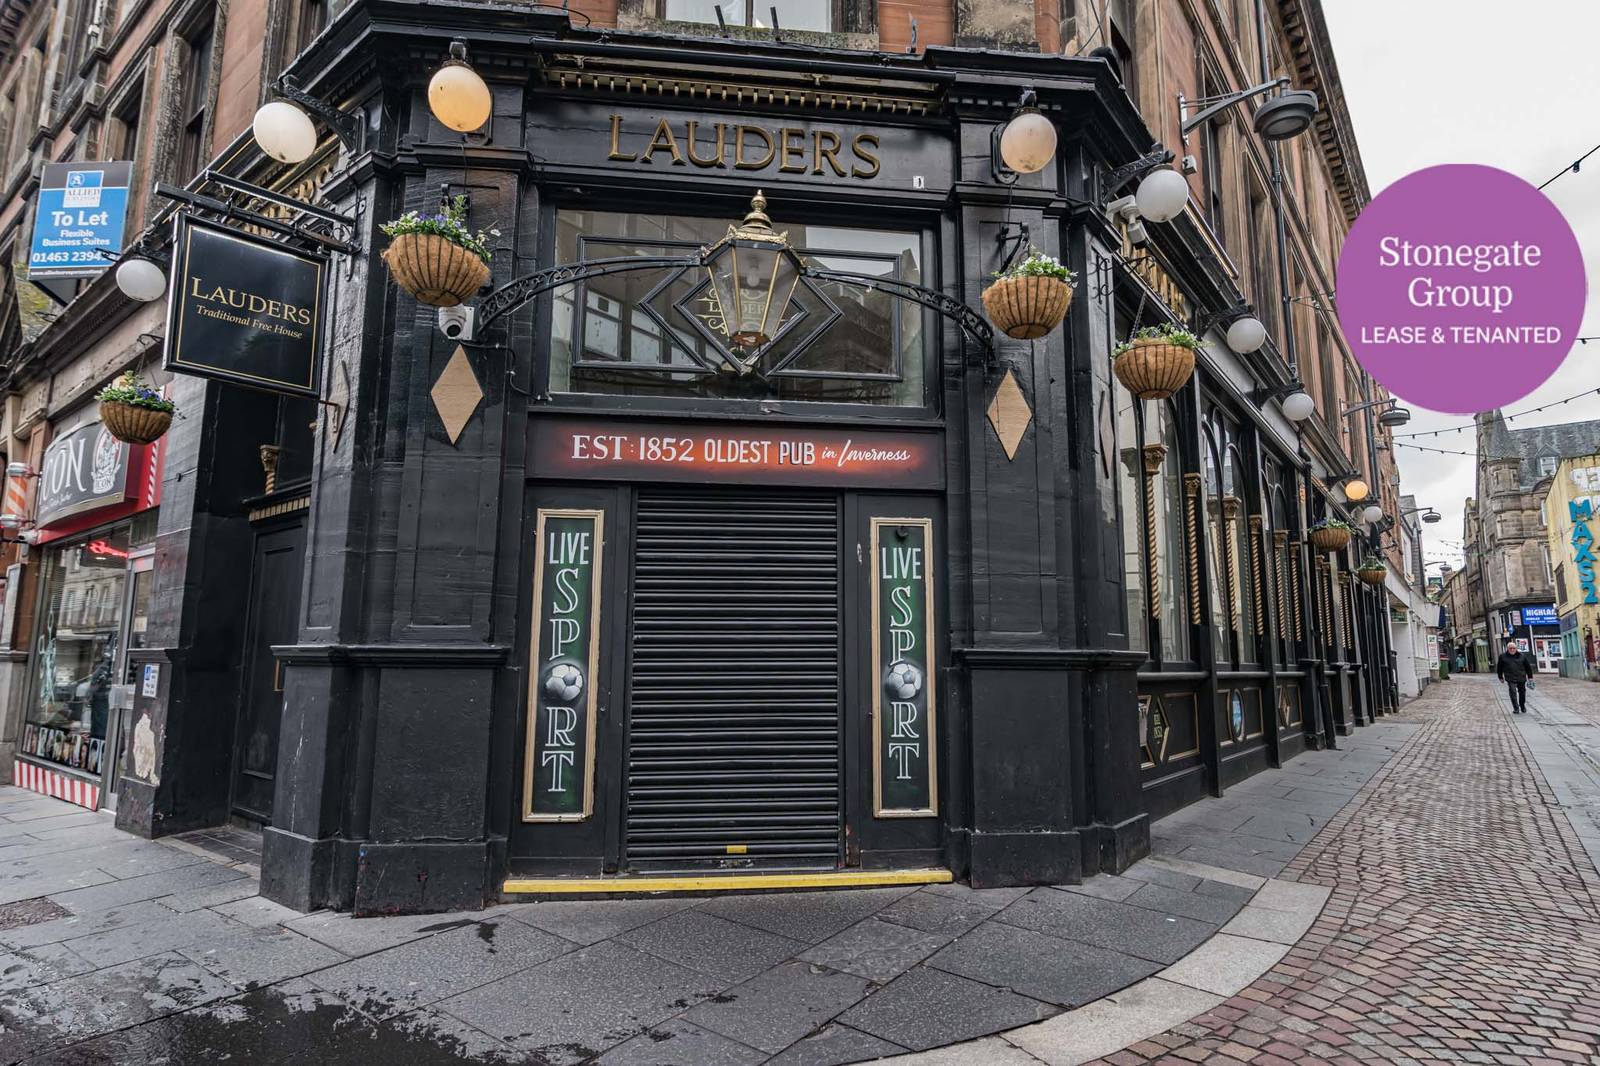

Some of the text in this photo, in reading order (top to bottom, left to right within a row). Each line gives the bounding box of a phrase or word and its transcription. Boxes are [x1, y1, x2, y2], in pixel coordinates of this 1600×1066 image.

[608, 113, 881, 179] LAUDERS
[52, 210, 109, 227] To Let
[60, 229, 95, 238] Flexible
[32, 252, 69, 263] 01463
[42, 238, 111, 247] Business Suites
[191, 276, 311, 325] LAUDERS
[196, 304, 303, 340] Traditional Free House
[639, 437, 695, 462] 1852
[704, 438, 771, 465] OLDEST
[778, 440, 816, 466] PUB
[822, 446, 838, 460] in
[838, 439, 911, 468] Inverness
[550, 532, 589, 565] LIVE
[882, 547, 921, 580] LIVE
